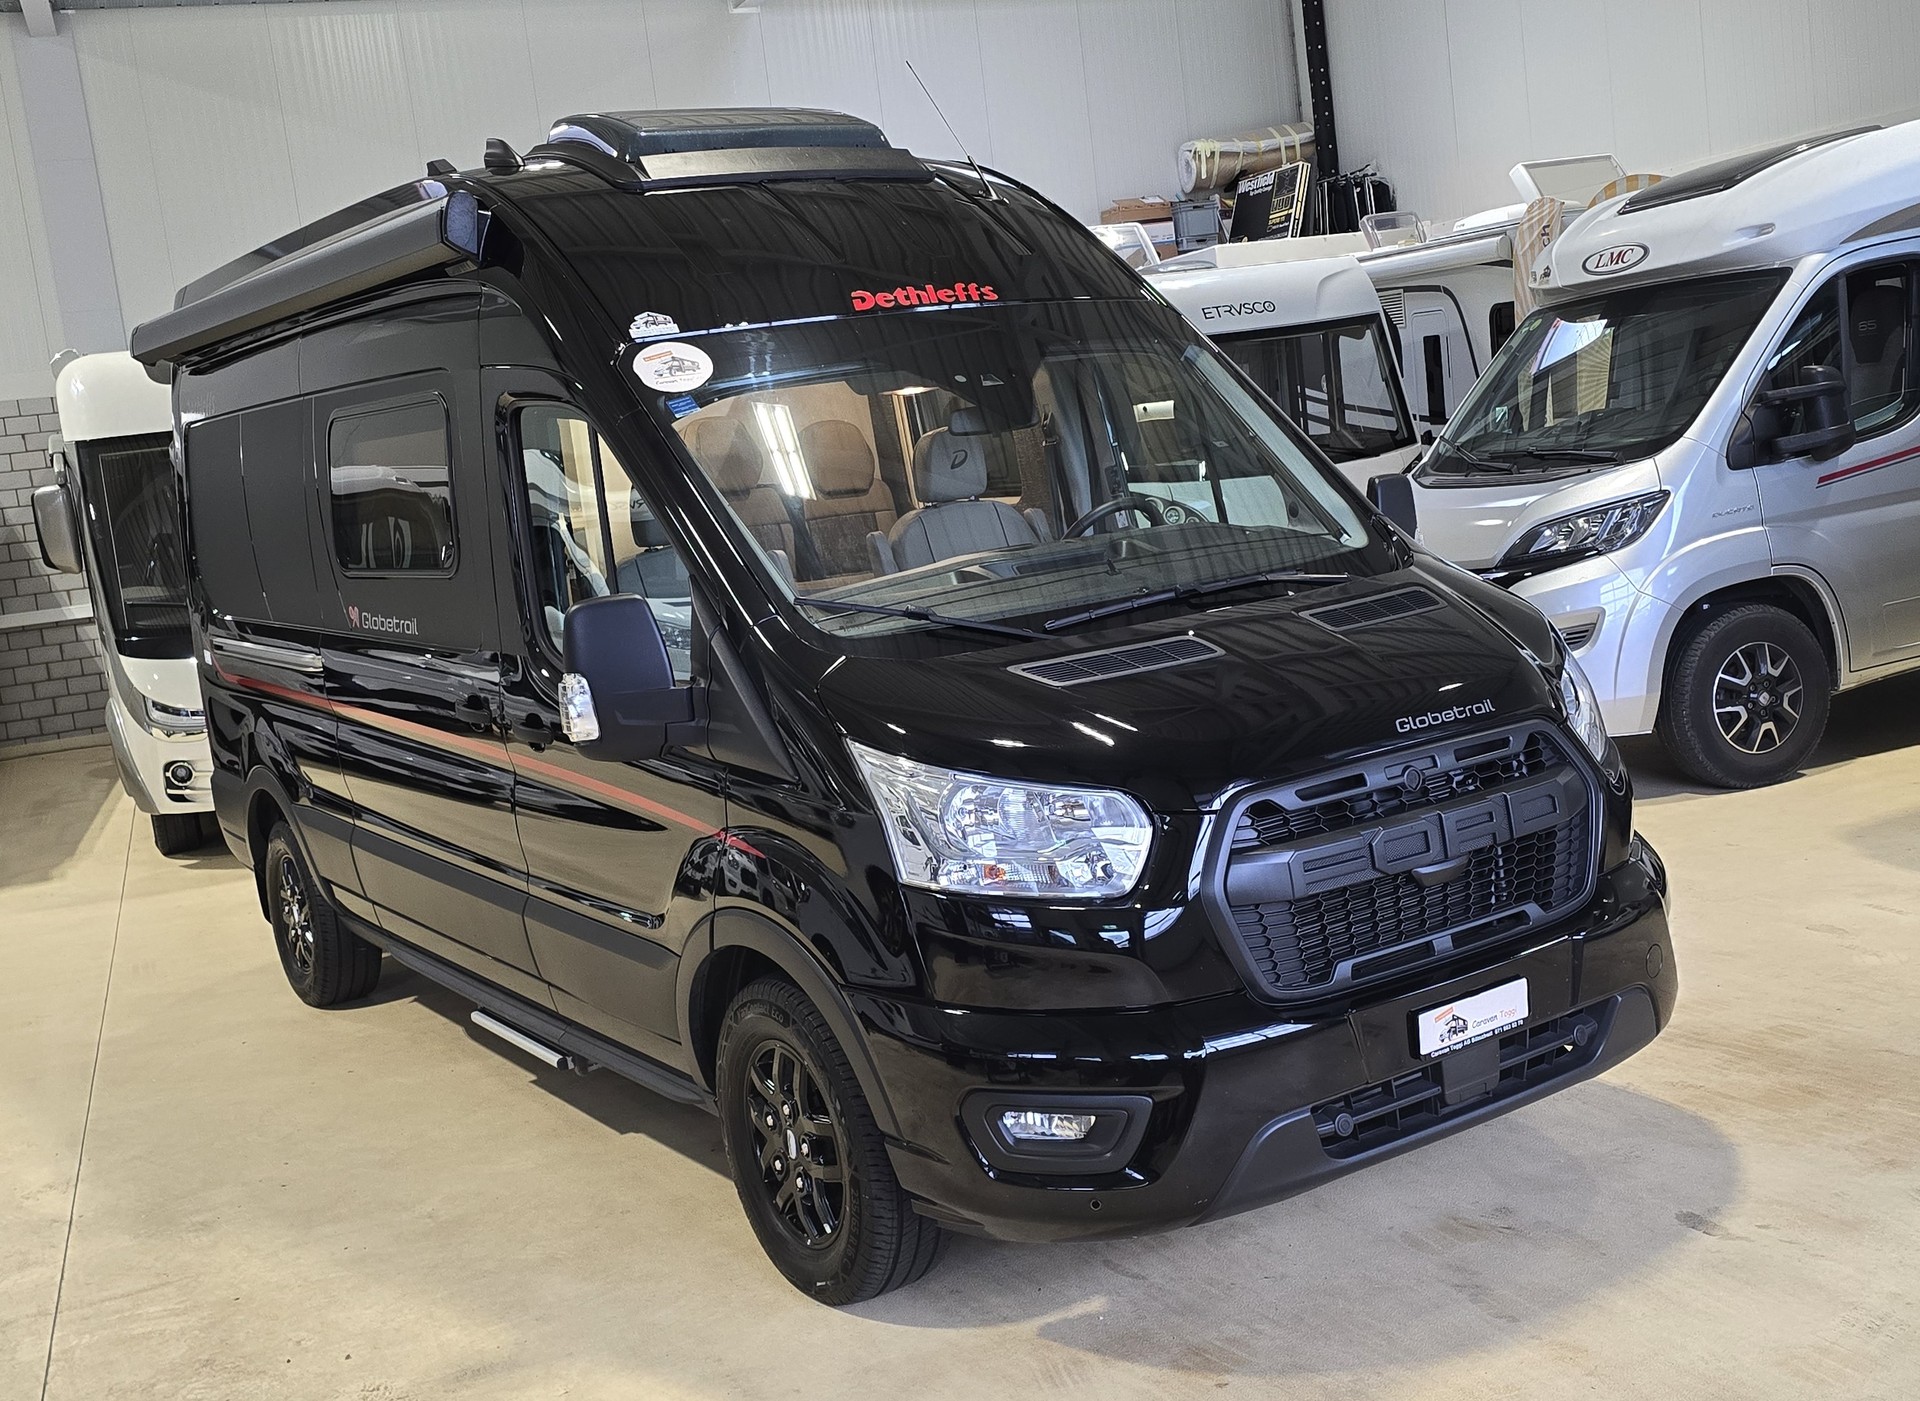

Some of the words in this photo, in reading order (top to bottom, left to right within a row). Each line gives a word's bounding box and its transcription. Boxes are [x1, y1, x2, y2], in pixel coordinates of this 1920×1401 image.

[1594, 248, 1634, 269] LMC
[851, 283, 998, 311] Dethleffs
[361, 612, 419, 635] Globetrail
[1395, 699, 1496, 733] Globetrail
[1289, 780, 1562, 899] FORD
[1471, 1014, 1498, 1029] Caravan
